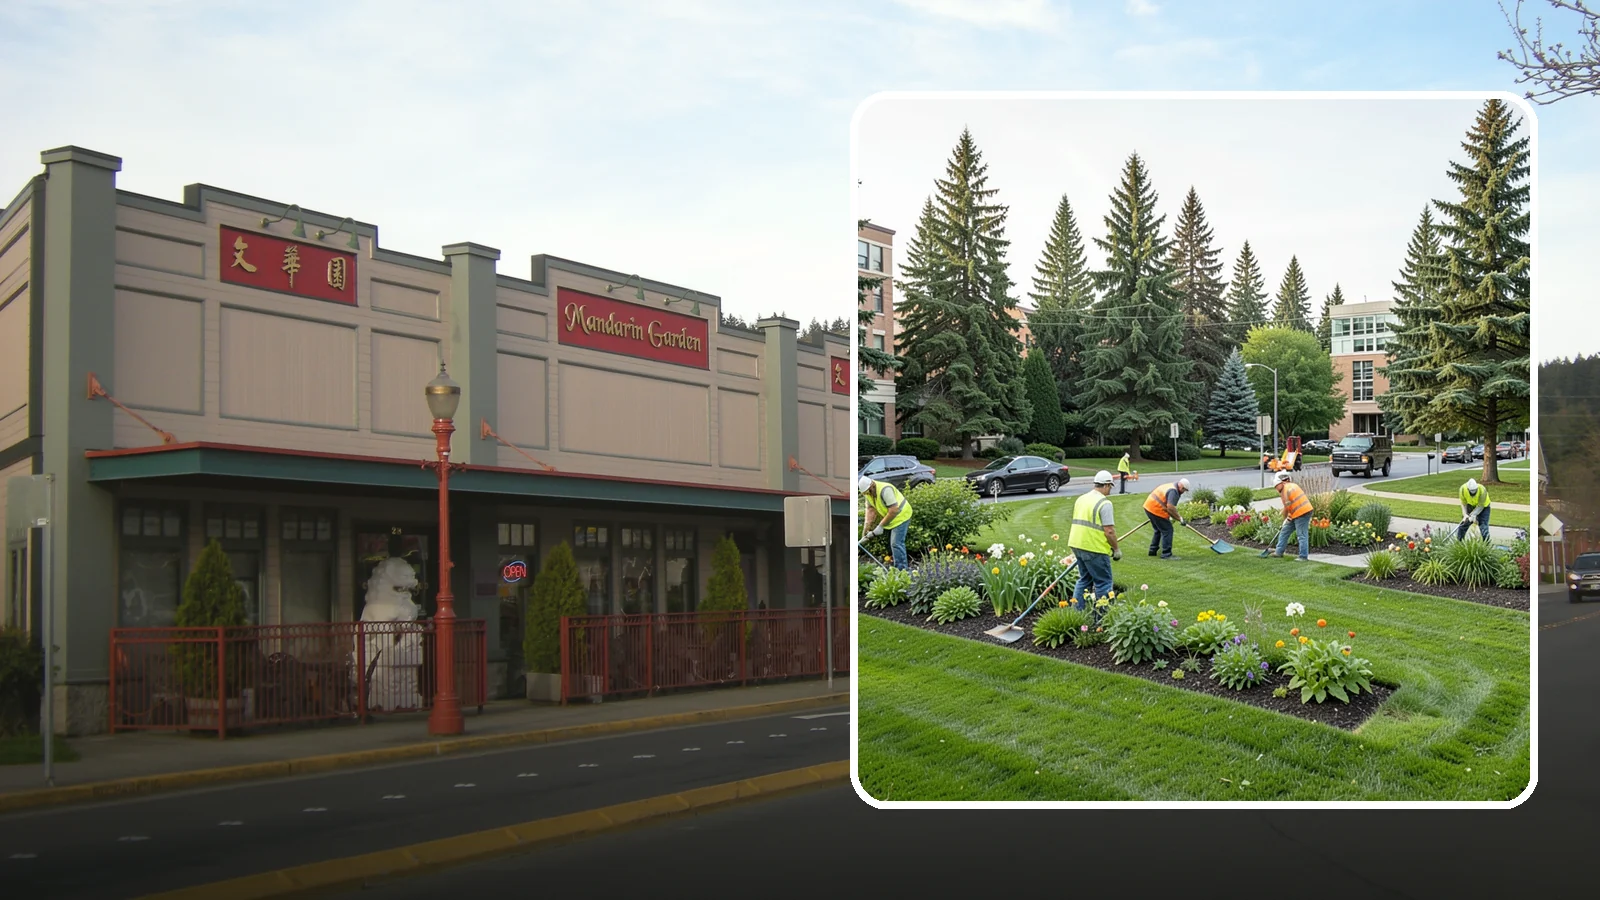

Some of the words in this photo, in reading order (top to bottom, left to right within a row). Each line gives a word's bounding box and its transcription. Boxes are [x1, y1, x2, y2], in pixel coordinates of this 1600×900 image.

[564, 302, 644, 341] Mandarin
[647, 320, 701, 352] Garden
[834, 363, 847, 386] 文
[503, 565, 527, 578] OPEN
